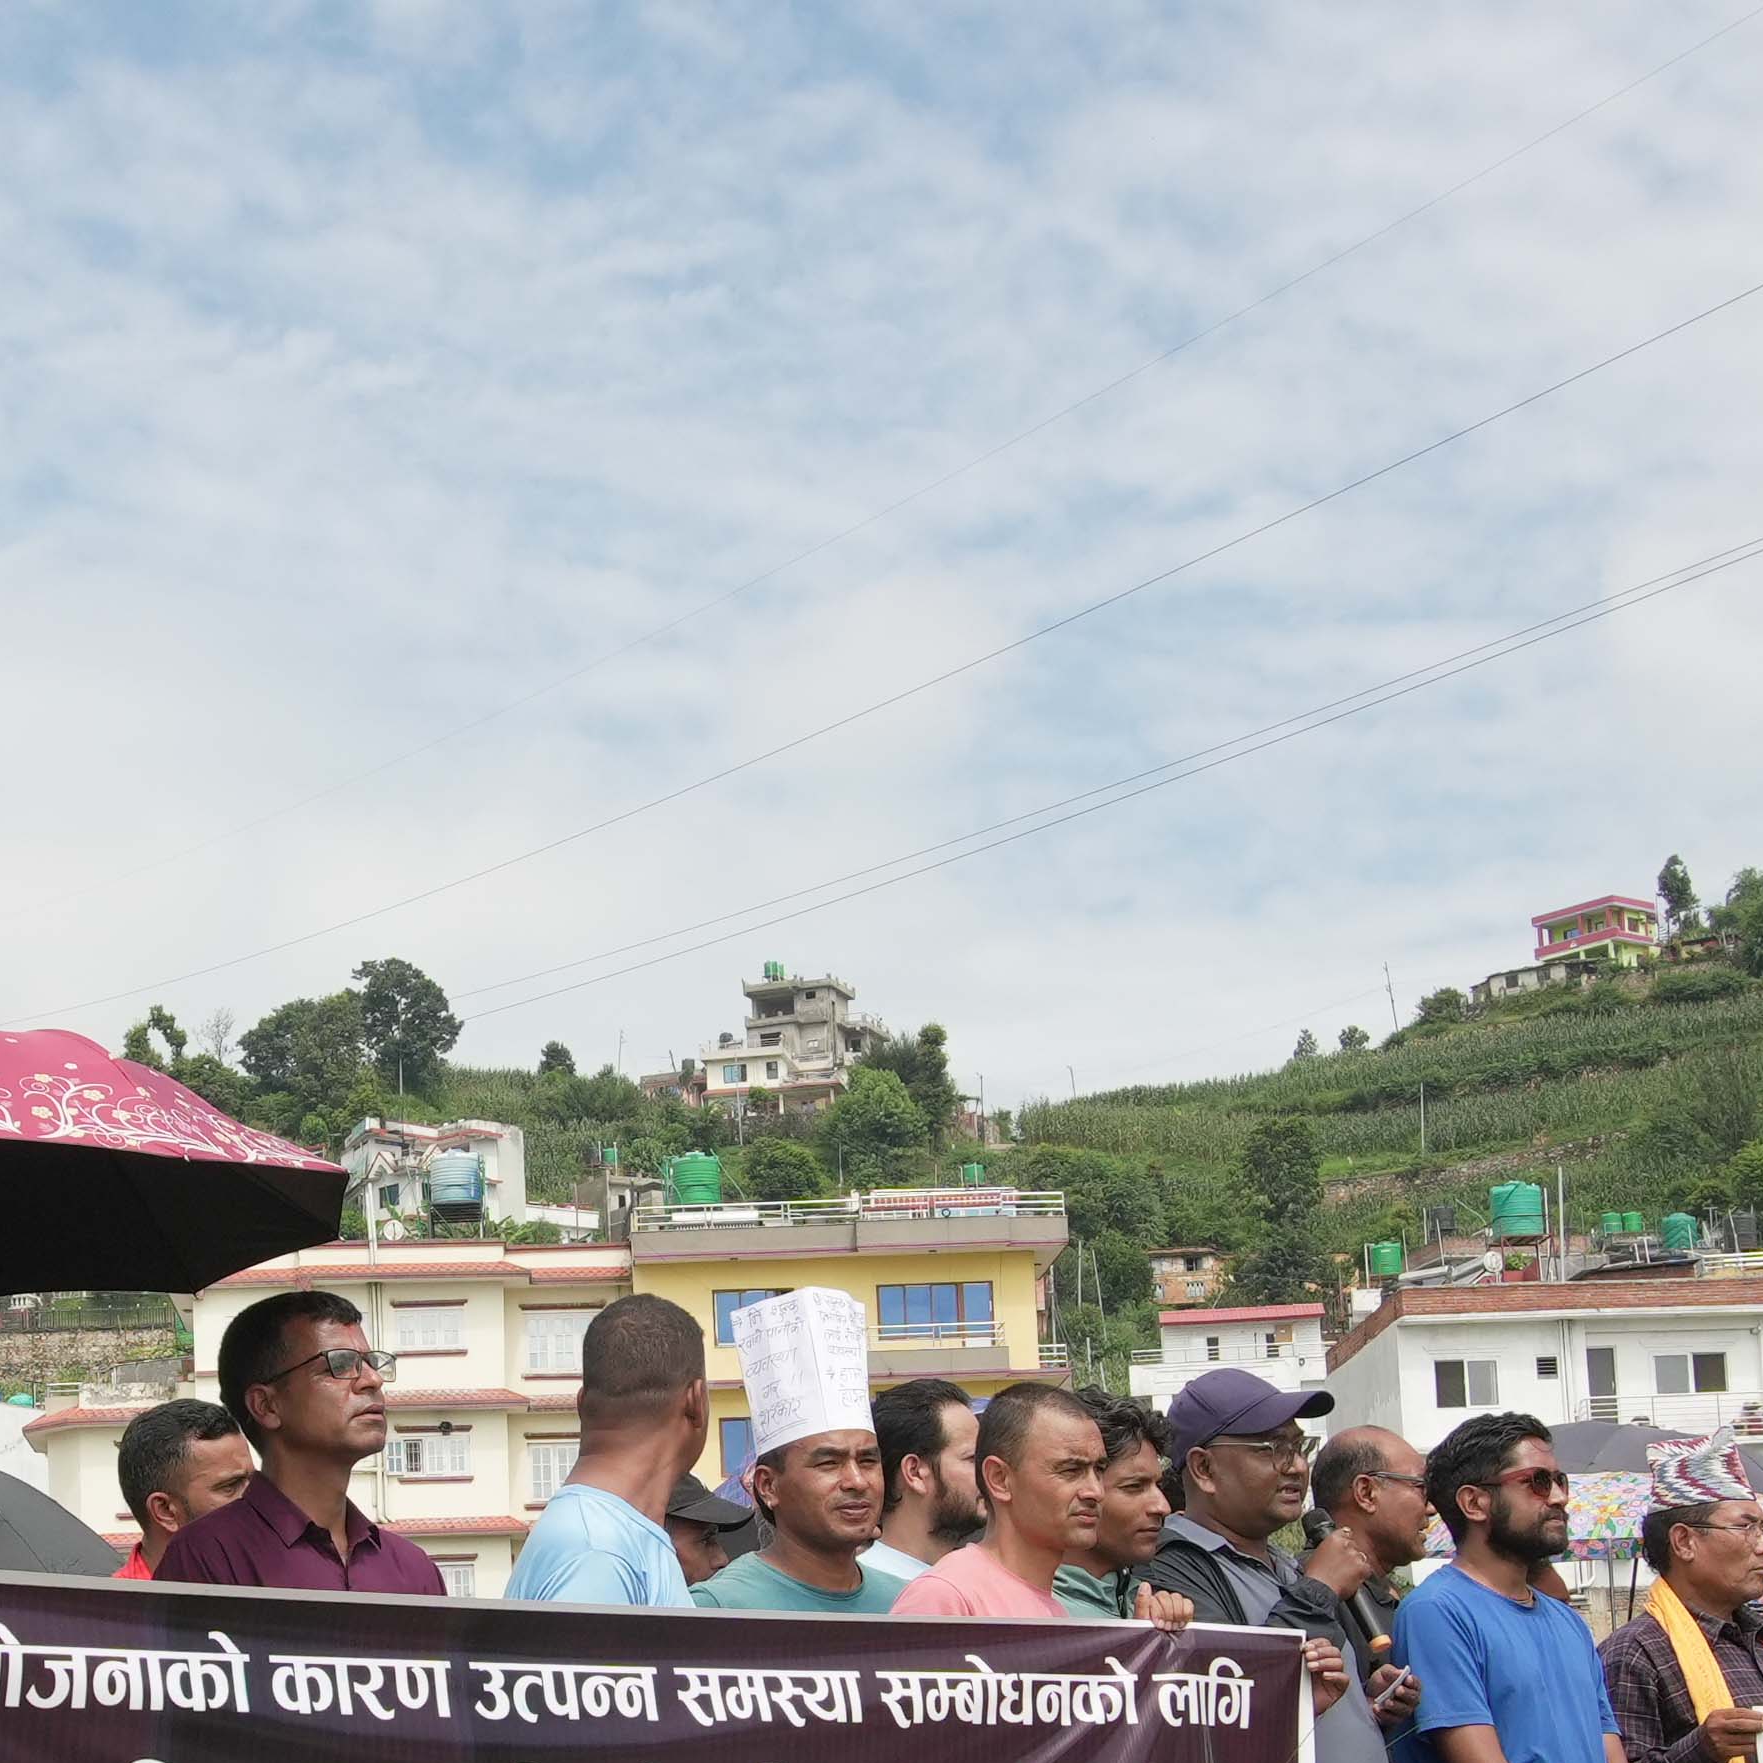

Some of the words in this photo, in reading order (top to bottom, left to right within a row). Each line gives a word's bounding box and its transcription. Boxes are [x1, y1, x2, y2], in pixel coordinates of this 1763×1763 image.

[269, 1655, 451, 1720] कारण
[469, 1662, 659, 1723] उत्पन्न
[673, 1667, 862, 1727] समस्या
[875, 1655, 1139, 1728] सम्बोधनको
[1152, 1657, 1254, 1728] लागि
